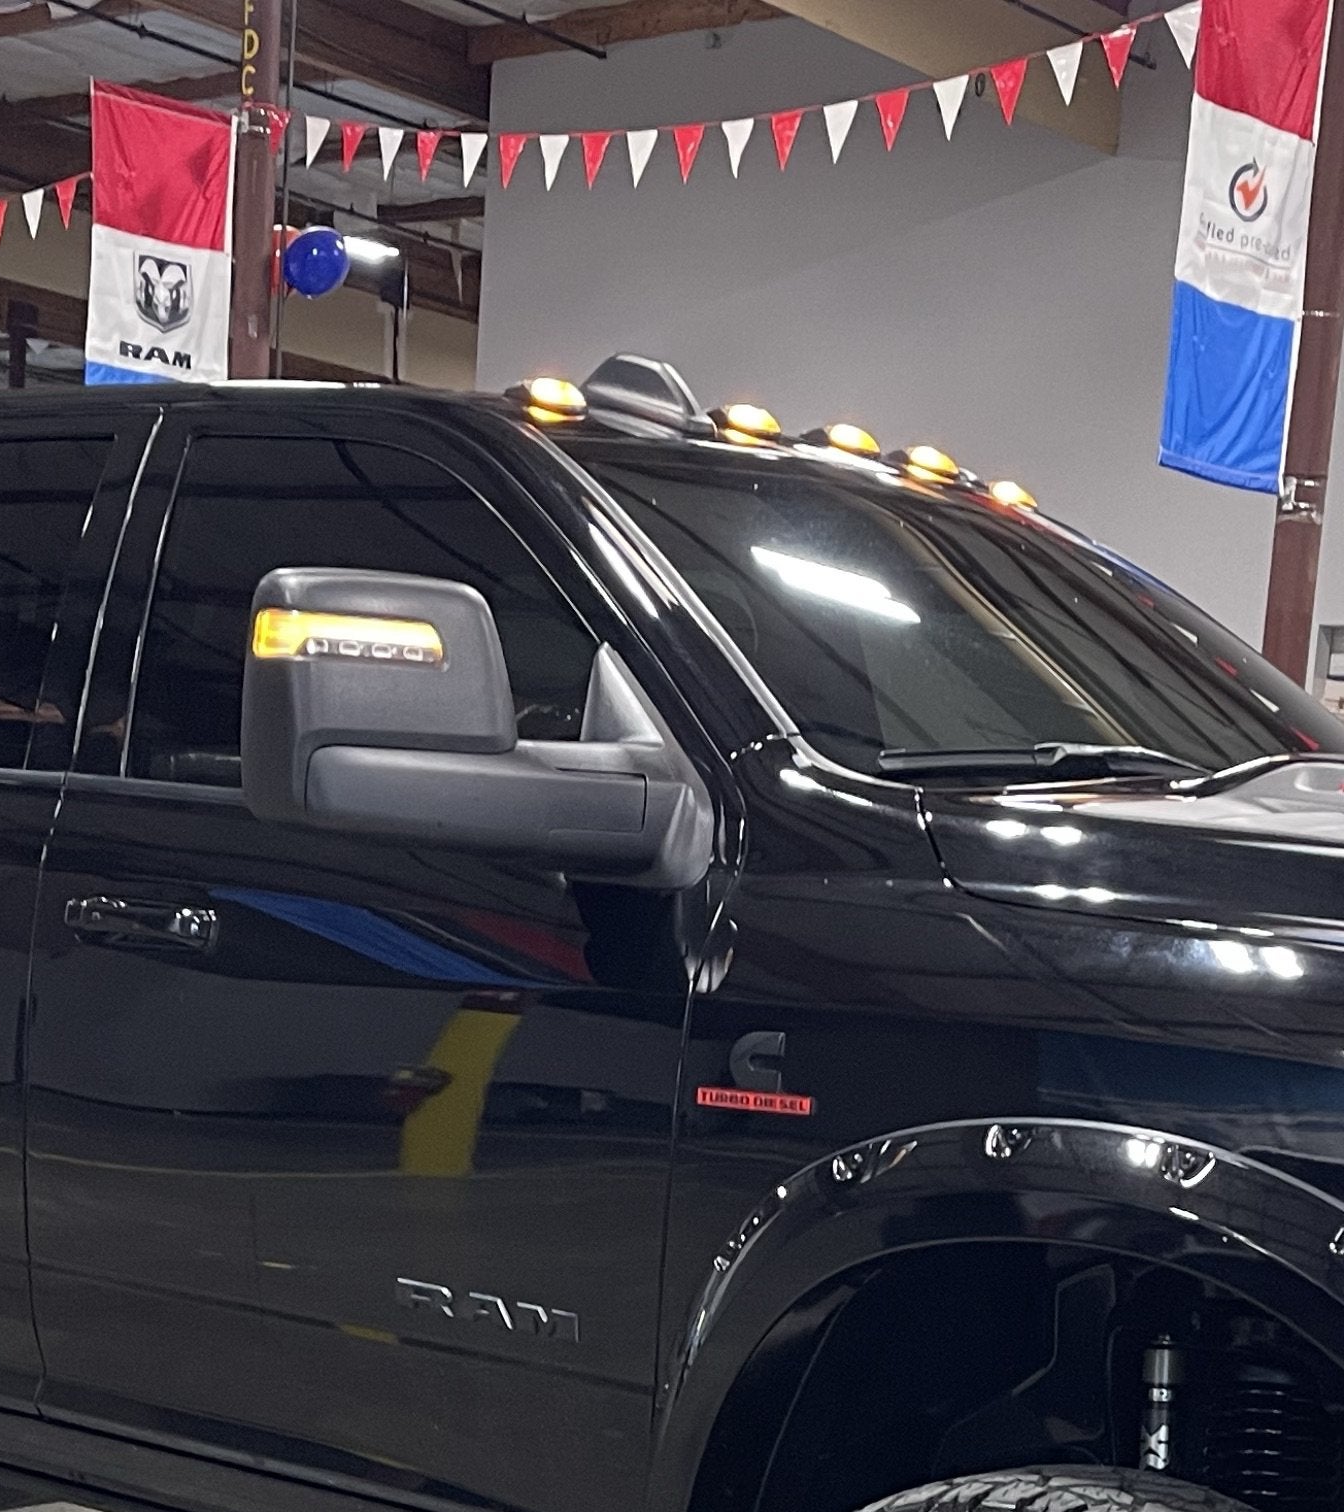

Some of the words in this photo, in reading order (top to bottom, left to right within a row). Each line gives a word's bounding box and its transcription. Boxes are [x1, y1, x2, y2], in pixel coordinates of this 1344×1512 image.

[119, 340, 192, 371] RAM
[700, 1089, 751, 1106] TURBO
[752, 1095, 808, 1112] DIESEL
[396, 1276, 580, 1343] RAM
